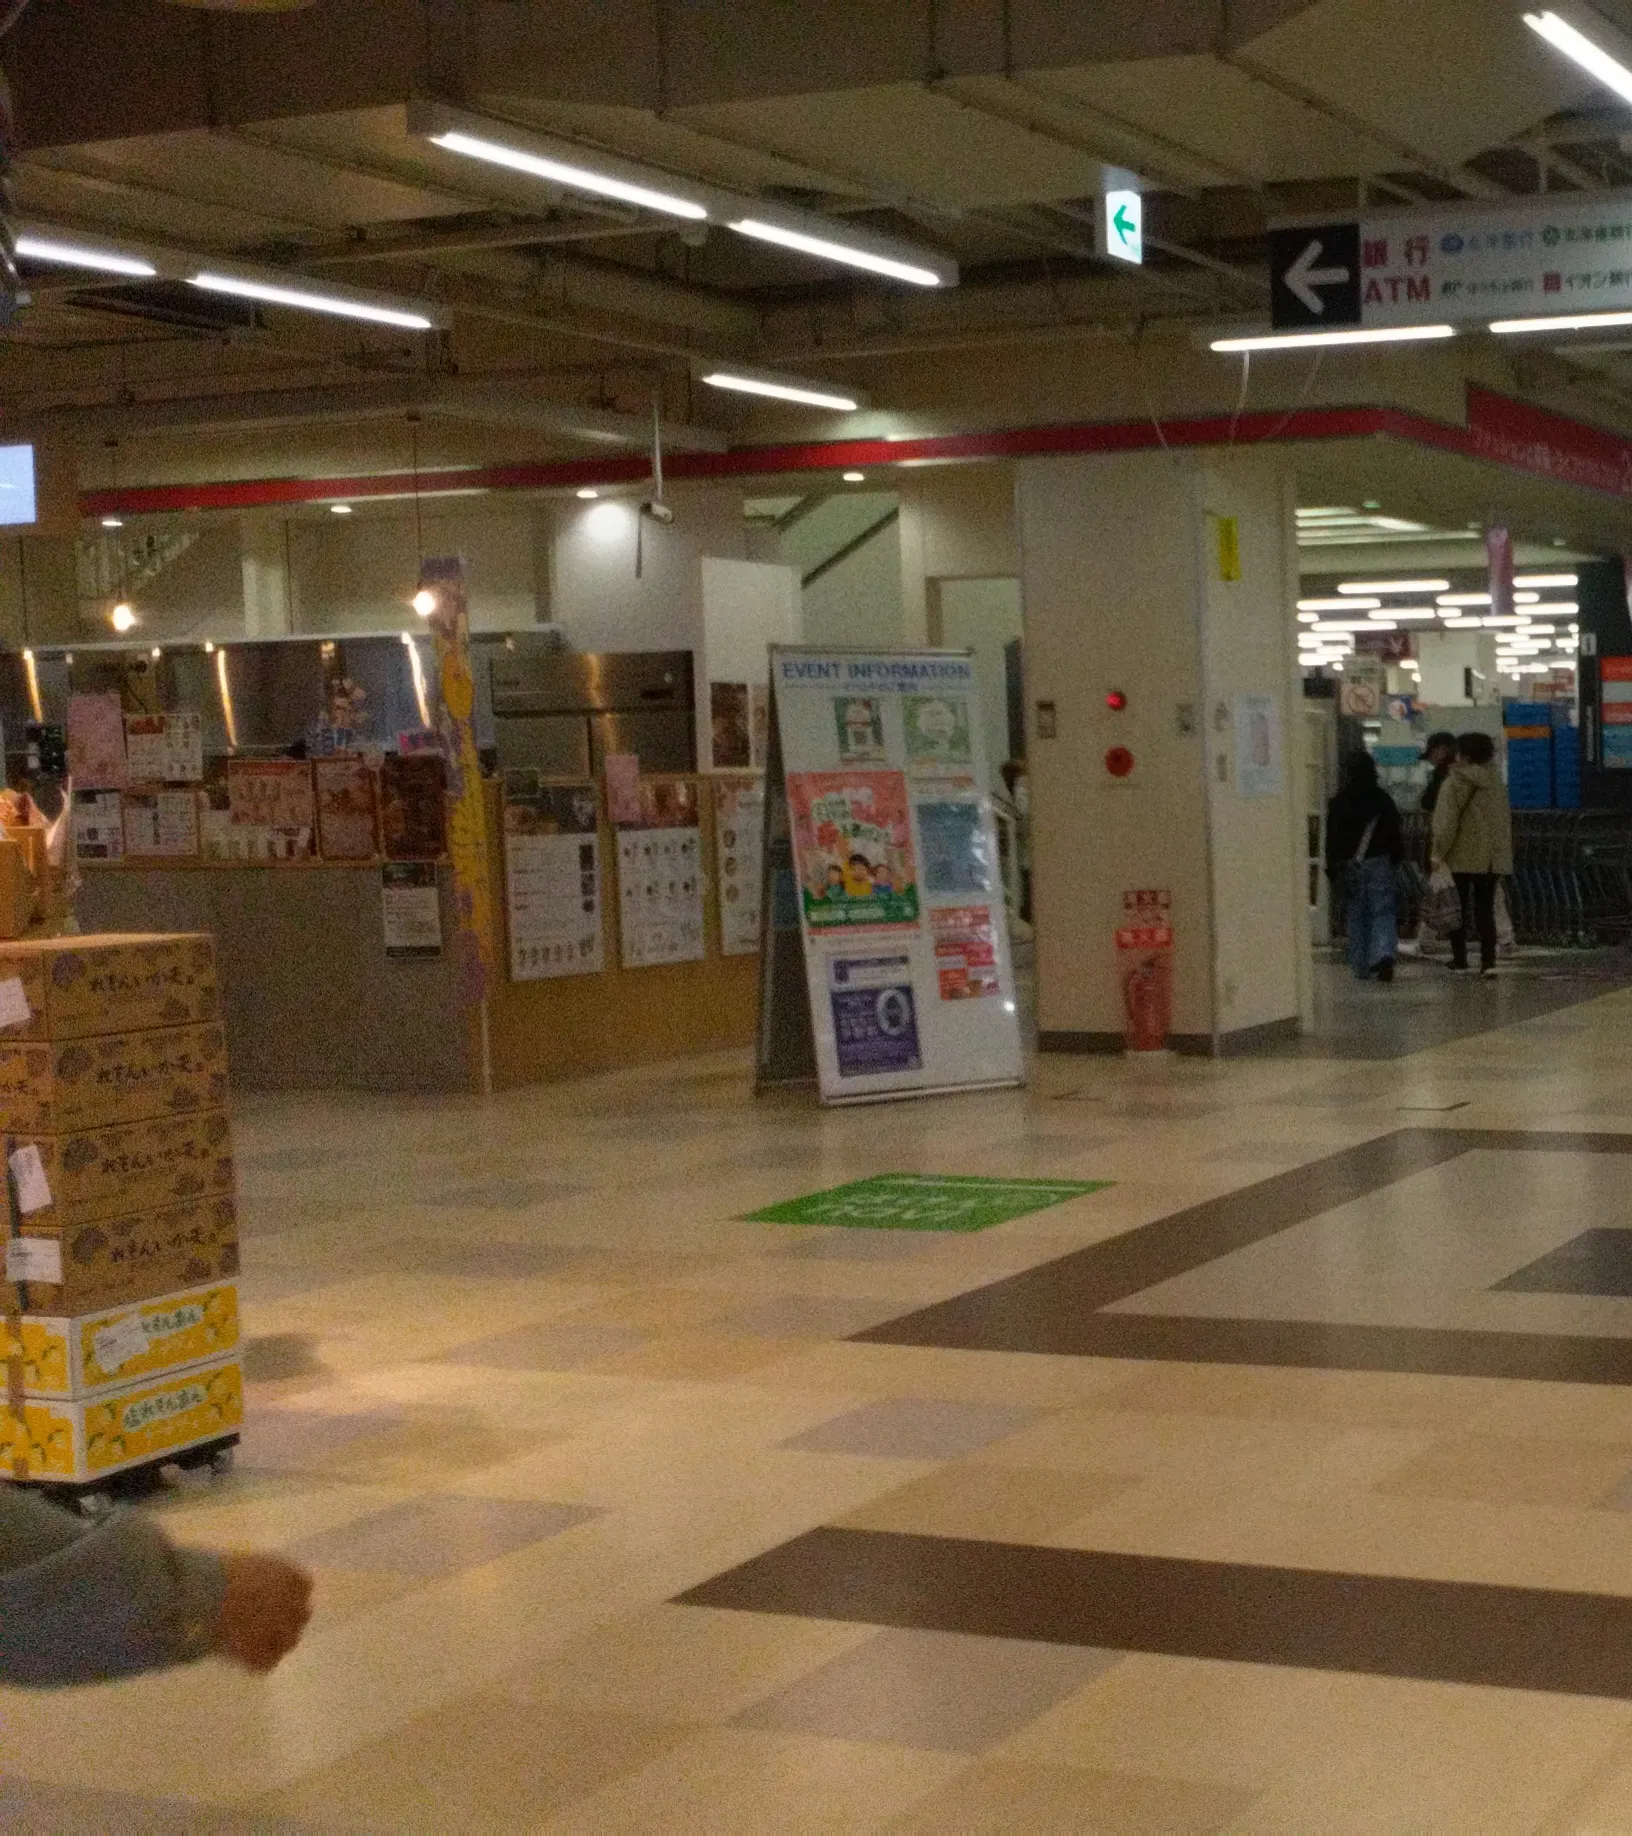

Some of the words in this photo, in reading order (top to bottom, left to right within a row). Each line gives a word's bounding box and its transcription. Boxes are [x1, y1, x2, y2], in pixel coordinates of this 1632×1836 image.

[1363, 235, 1430, 267] 銀行
[1363, 275, 1431, 305] ATM
[783, 661, 840, 680] EVENT
[848, 661, 973, 680] INFORMATION
